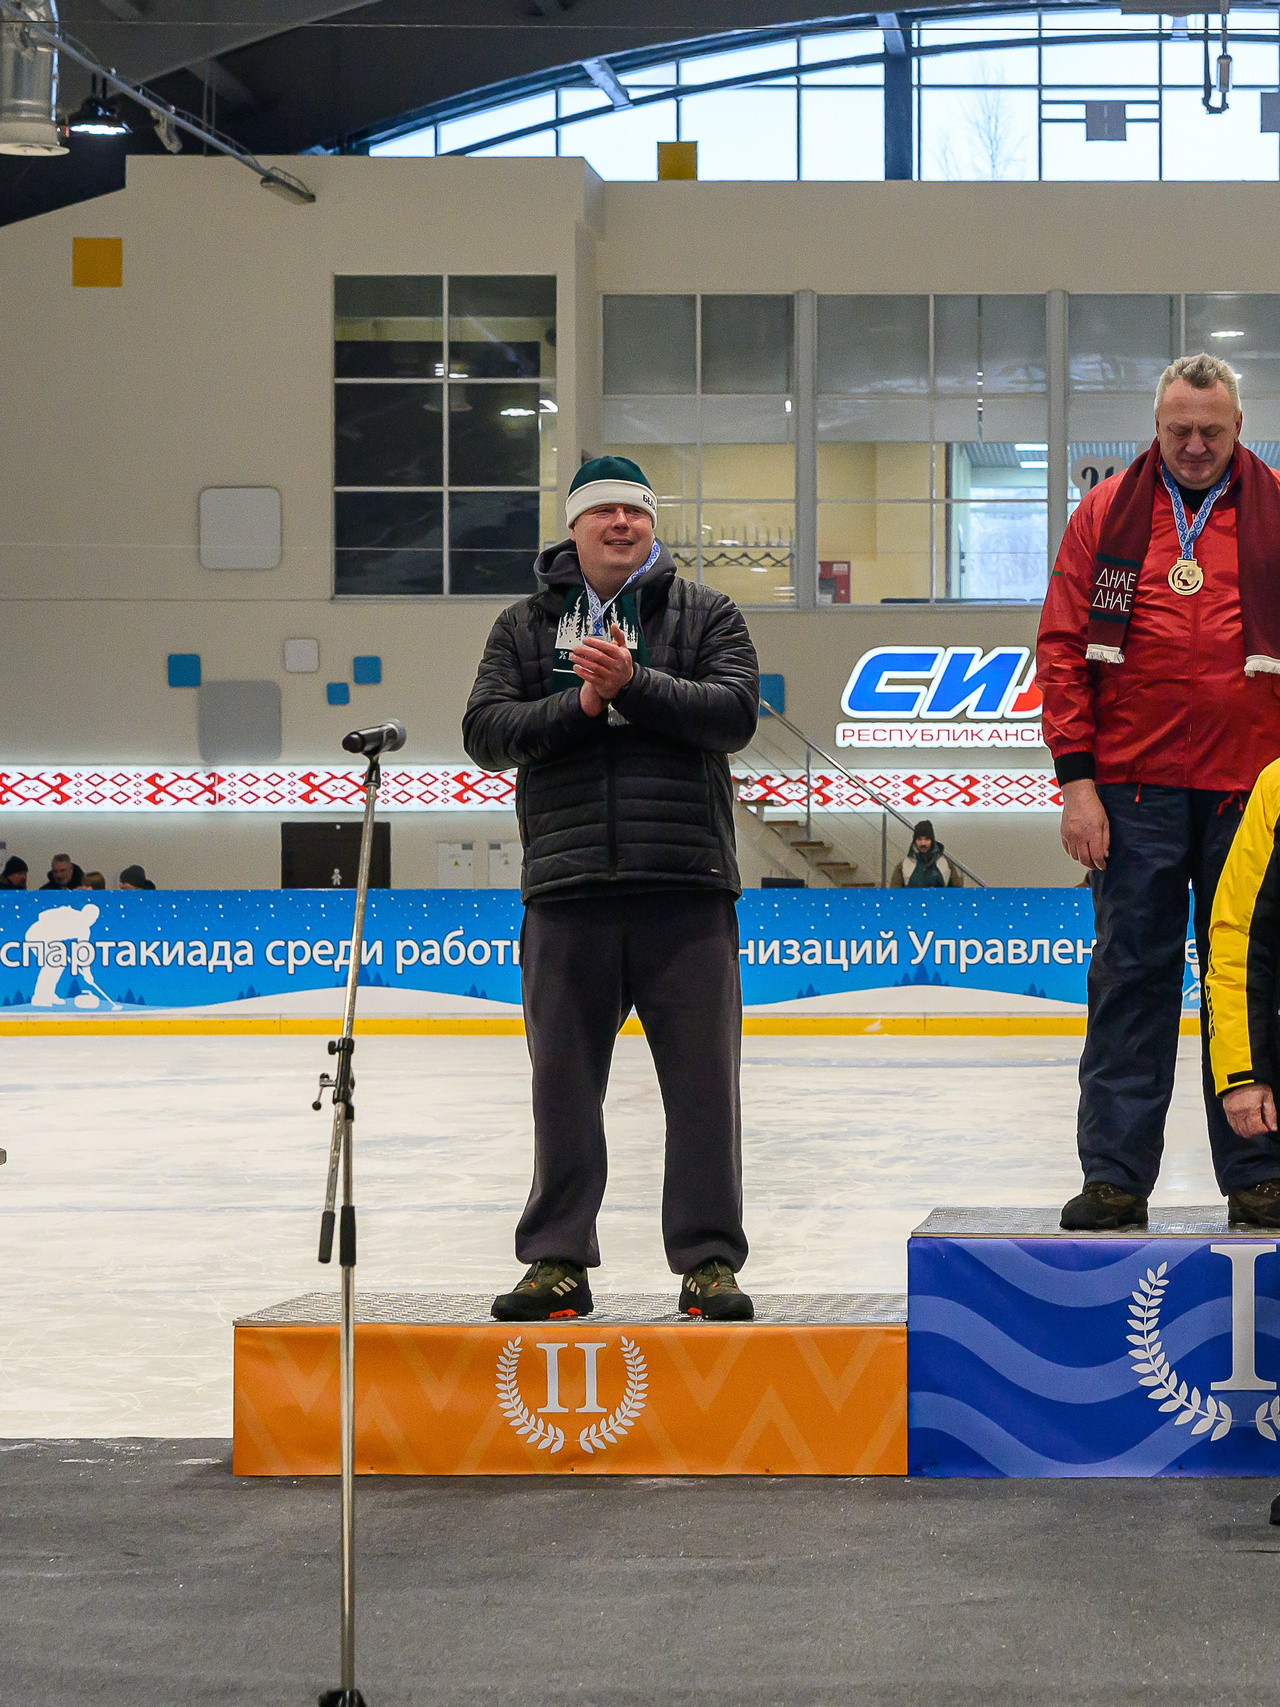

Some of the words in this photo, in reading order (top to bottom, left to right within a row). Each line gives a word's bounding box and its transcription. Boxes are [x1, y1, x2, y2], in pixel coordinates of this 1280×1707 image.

[0, 939, 254, 976] спартакиада
[265, 938, 383, 975] среди
[535, 1342, 607, 1413] II
